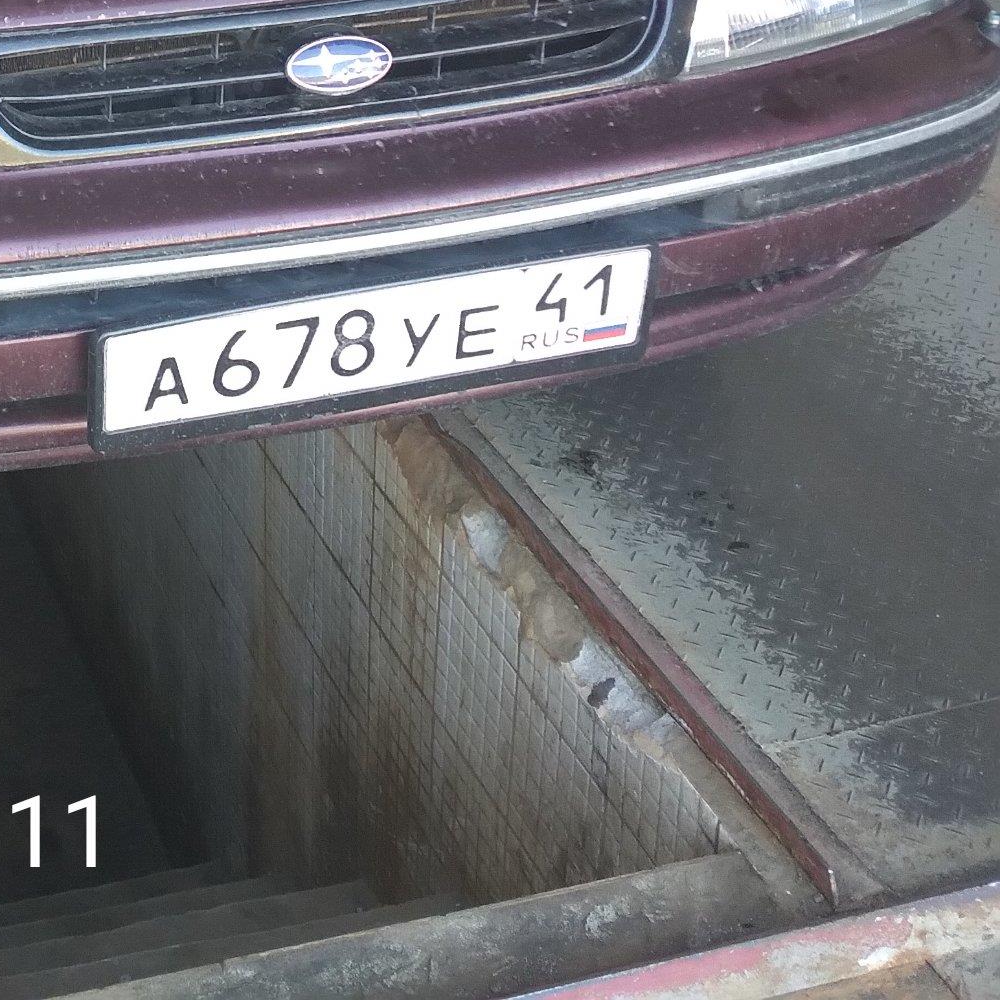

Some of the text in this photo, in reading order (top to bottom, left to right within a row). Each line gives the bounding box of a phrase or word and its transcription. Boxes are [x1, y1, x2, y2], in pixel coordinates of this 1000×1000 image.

[144, 264, 613, 412] А678УЕ 41
[521, 327, 579, 351] RUS
